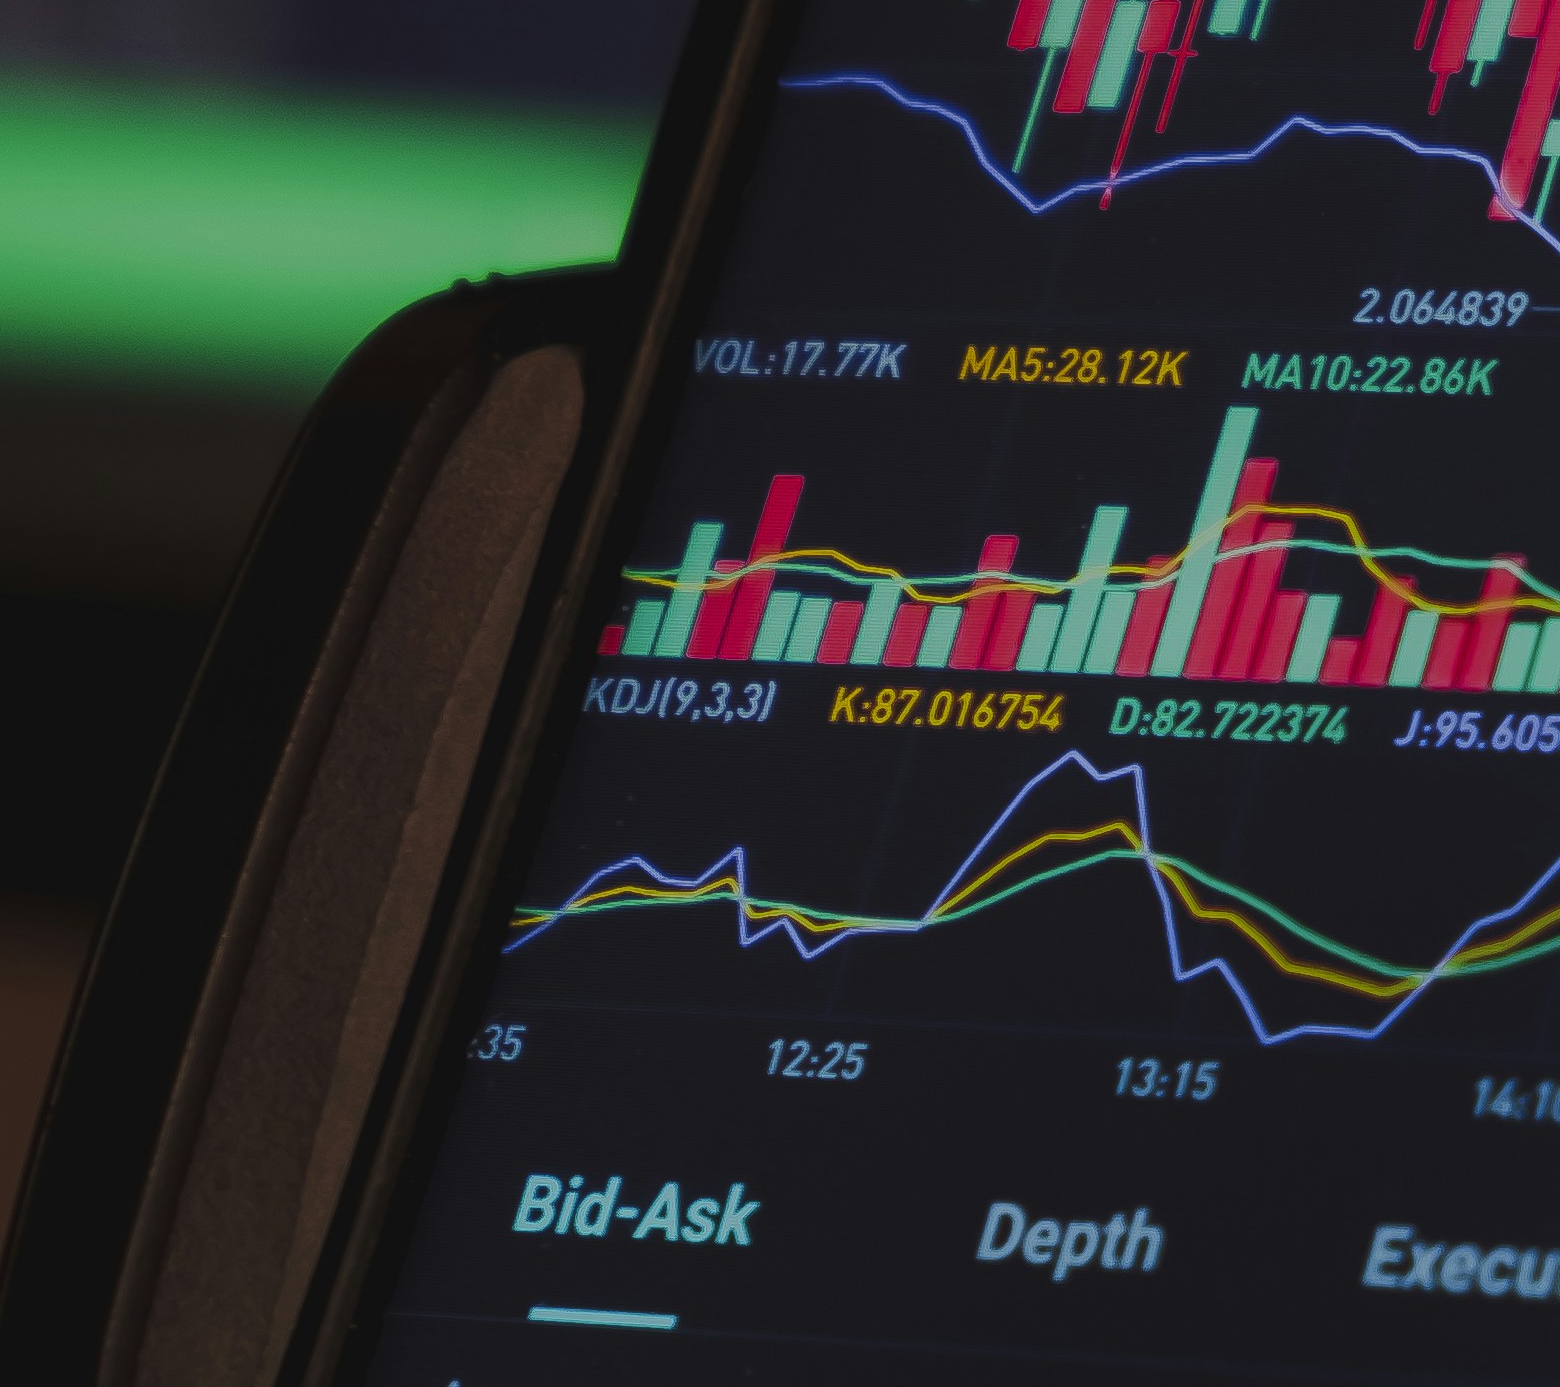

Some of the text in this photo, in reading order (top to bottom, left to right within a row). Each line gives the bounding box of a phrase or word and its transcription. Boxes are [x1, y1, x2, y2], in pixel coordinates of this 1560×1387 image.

[1351, 286, 1531, 329] 2.064839
[694, 338, 909, 380] VOL:17.77K
[958, 344, 1190, 389] MA5:28.12K
[1240, 351, 1499, 397] MA10:22.86K
[582, 675, 779, 725] KDJ(9,3,3)
[828, 685, 1065, 733] K:87.016754
[1107, 695, 1349, 745] D:82.722374
[766, 1037, 870, 1082] 12:25
[1115, 1056, 1221, 1102] 13:15
[511, 1172, 762, 1248] Bid-Ask
[975, 1200, 1165, 1283] Depth
